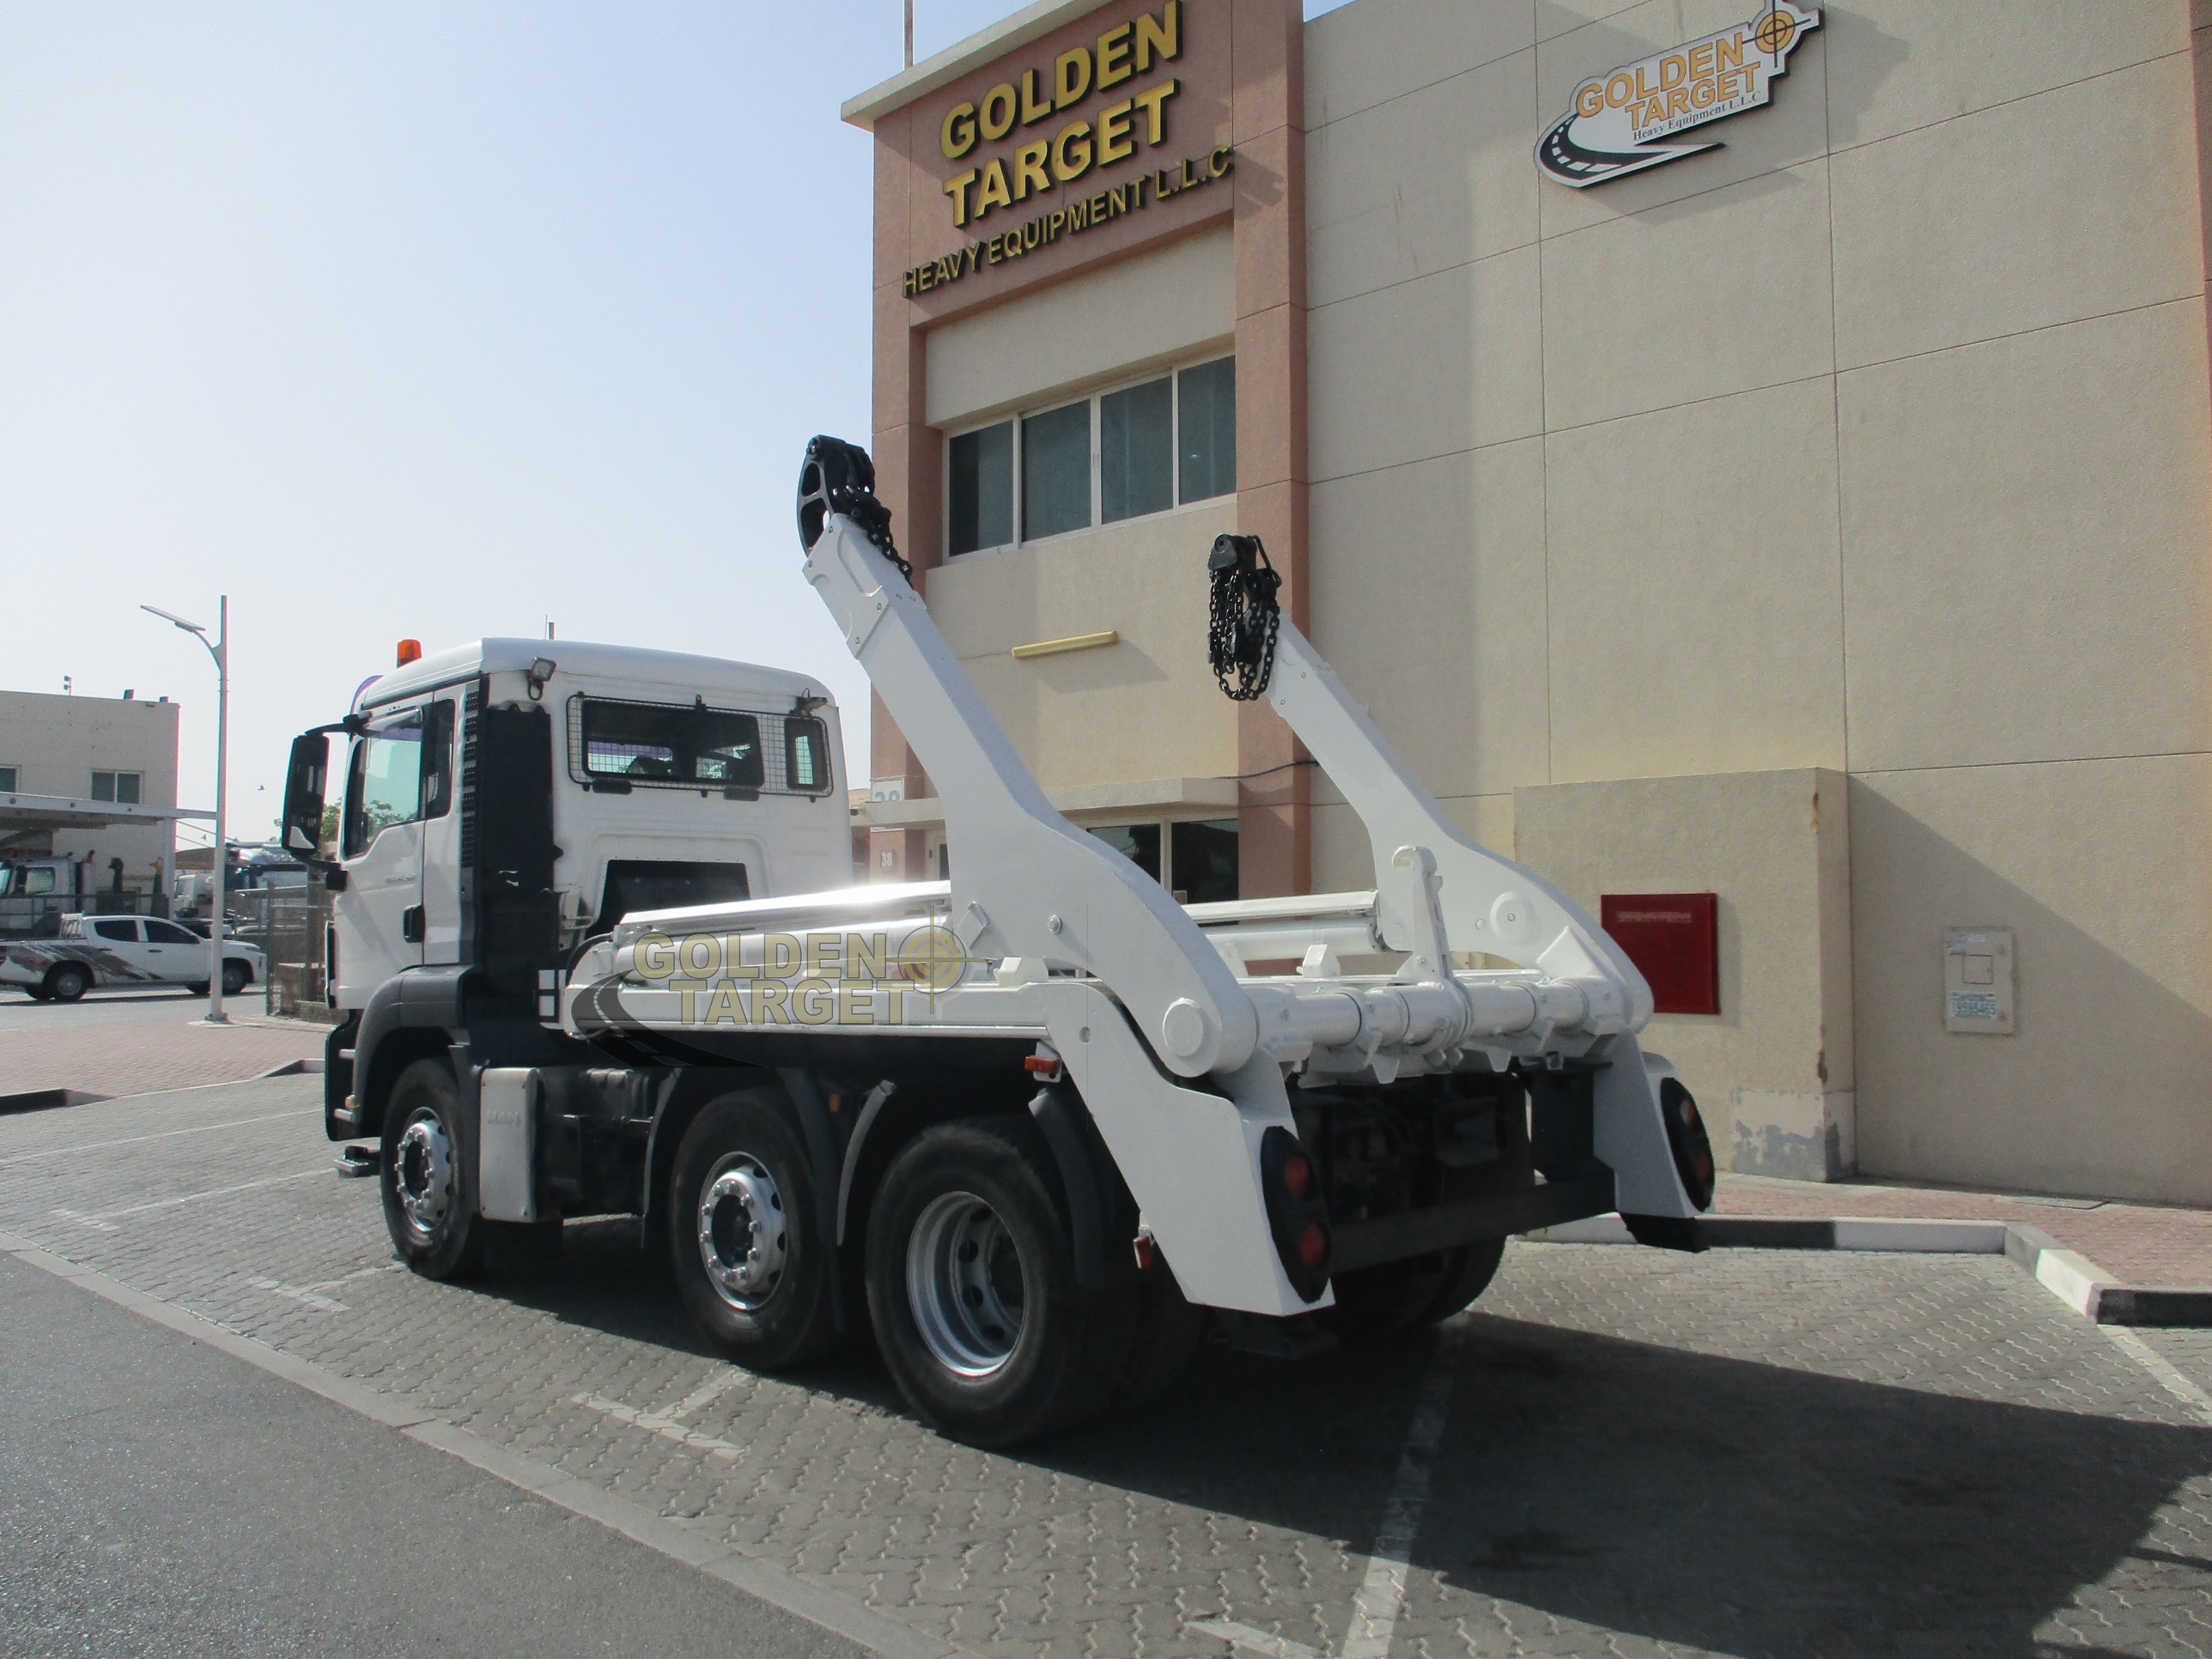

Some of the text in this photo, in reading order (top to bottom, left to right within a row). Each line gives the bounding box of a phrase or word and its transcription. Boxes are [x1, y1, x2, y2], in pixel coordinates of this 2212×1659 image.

[939, 0, 1181, 159] GOLDEN
[1576, 32, 1743, 118] GOLDEN
[1625, 61, 1761, 131] TARGET
[1632, 90, 1760, 141] Heavy Equipment L.L.C
[944, 79, 1177, 227] TARGET
[902, 145, 1233, 298] HEAVY EQUIPMENT L.L.C
[881, 852, 893, 866] 38
